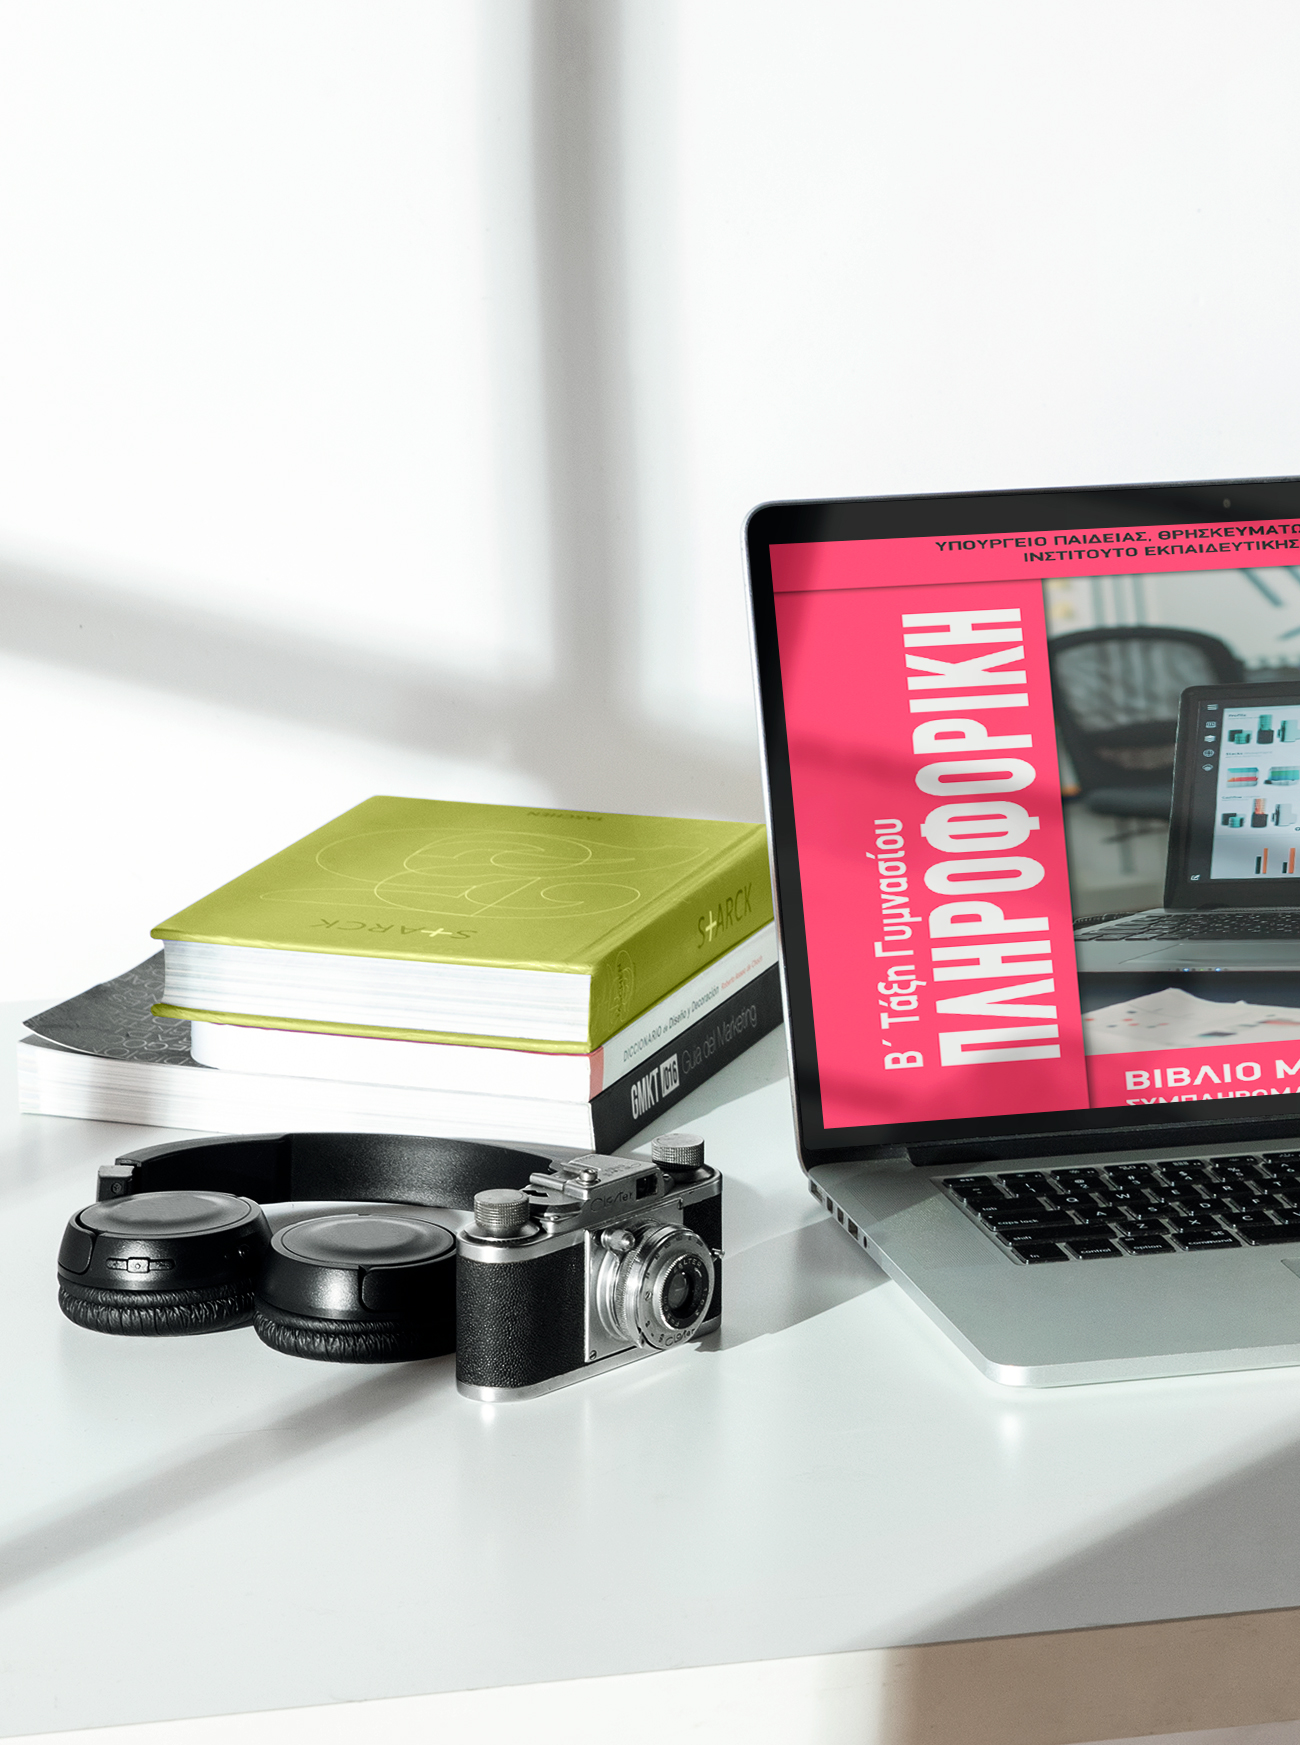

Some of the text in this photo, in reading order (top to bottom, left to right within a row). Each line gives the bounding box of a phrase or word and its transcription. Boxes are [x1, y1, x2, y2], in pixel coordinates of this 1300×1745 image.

[936, 536, 1047, 552] ΥΠΟΥΡΓΕΙΟ
[1024, 547, 1138, 562] ΙΝΣΤΙΤΟΥΤΟ
[1145, 538, 1300, 556] ΕΚΠΑΙΔΕΥΤΙΚΗΣ
[902, 608, 1061, 1067] ΠΛΗΡΟΦΟΡΙΚΗ
[865, 818, 923, 958] Γυμνασίου
[876, 964, 927, 1030] Τάξη
[623, 1025, 662, 1062] DICCIONARIO
[631, 1067, 659, 1120] GMKT
[1125, 1062, 1262, 1091] ΒΙΒΛΙΟ
